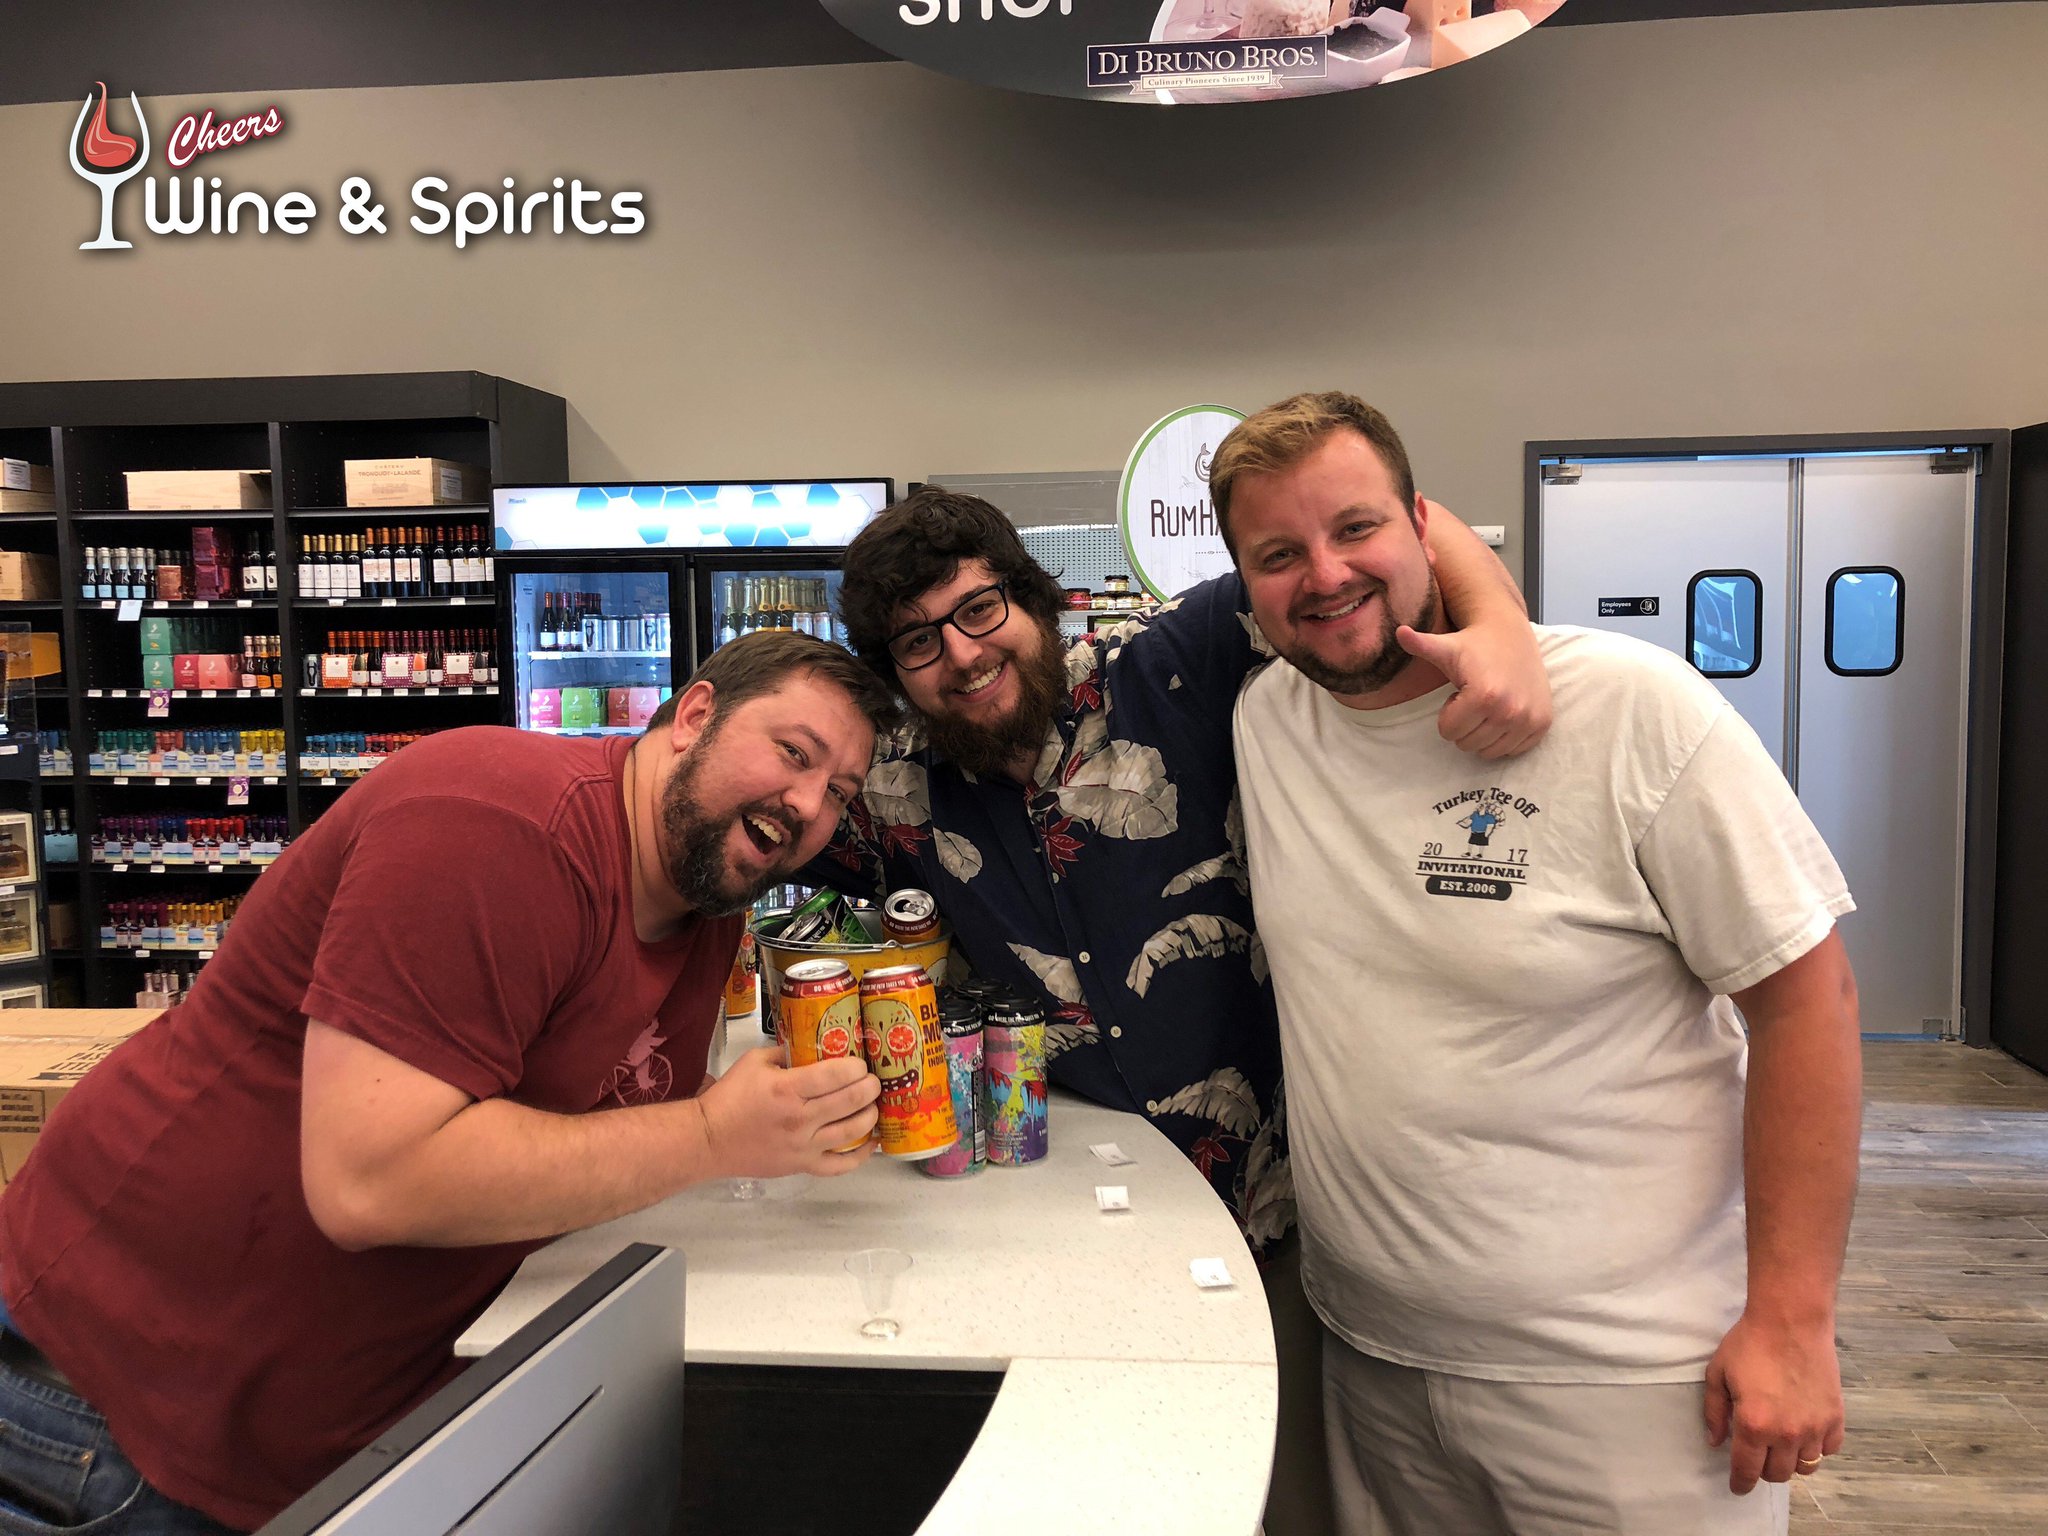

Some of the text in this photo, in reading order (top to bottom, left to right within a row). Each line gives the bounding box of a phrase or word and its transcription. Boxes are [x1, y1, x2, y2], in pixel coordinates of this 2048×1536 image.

[1098, 45, 1319, 75] DI BRUNO BROS.
[1148, 74, 1265, 87] Culinary Pioneers Since 1939
[1432, 786, 1540, 819] Turkey Tee Off
[1423, 842, 1443, 856] 20
[1506, 848, 1529, 864] 17
[1417, 860, 1526, 880] INVITATIONAL
[1439, 880, 1497, 895] EST. 2006
